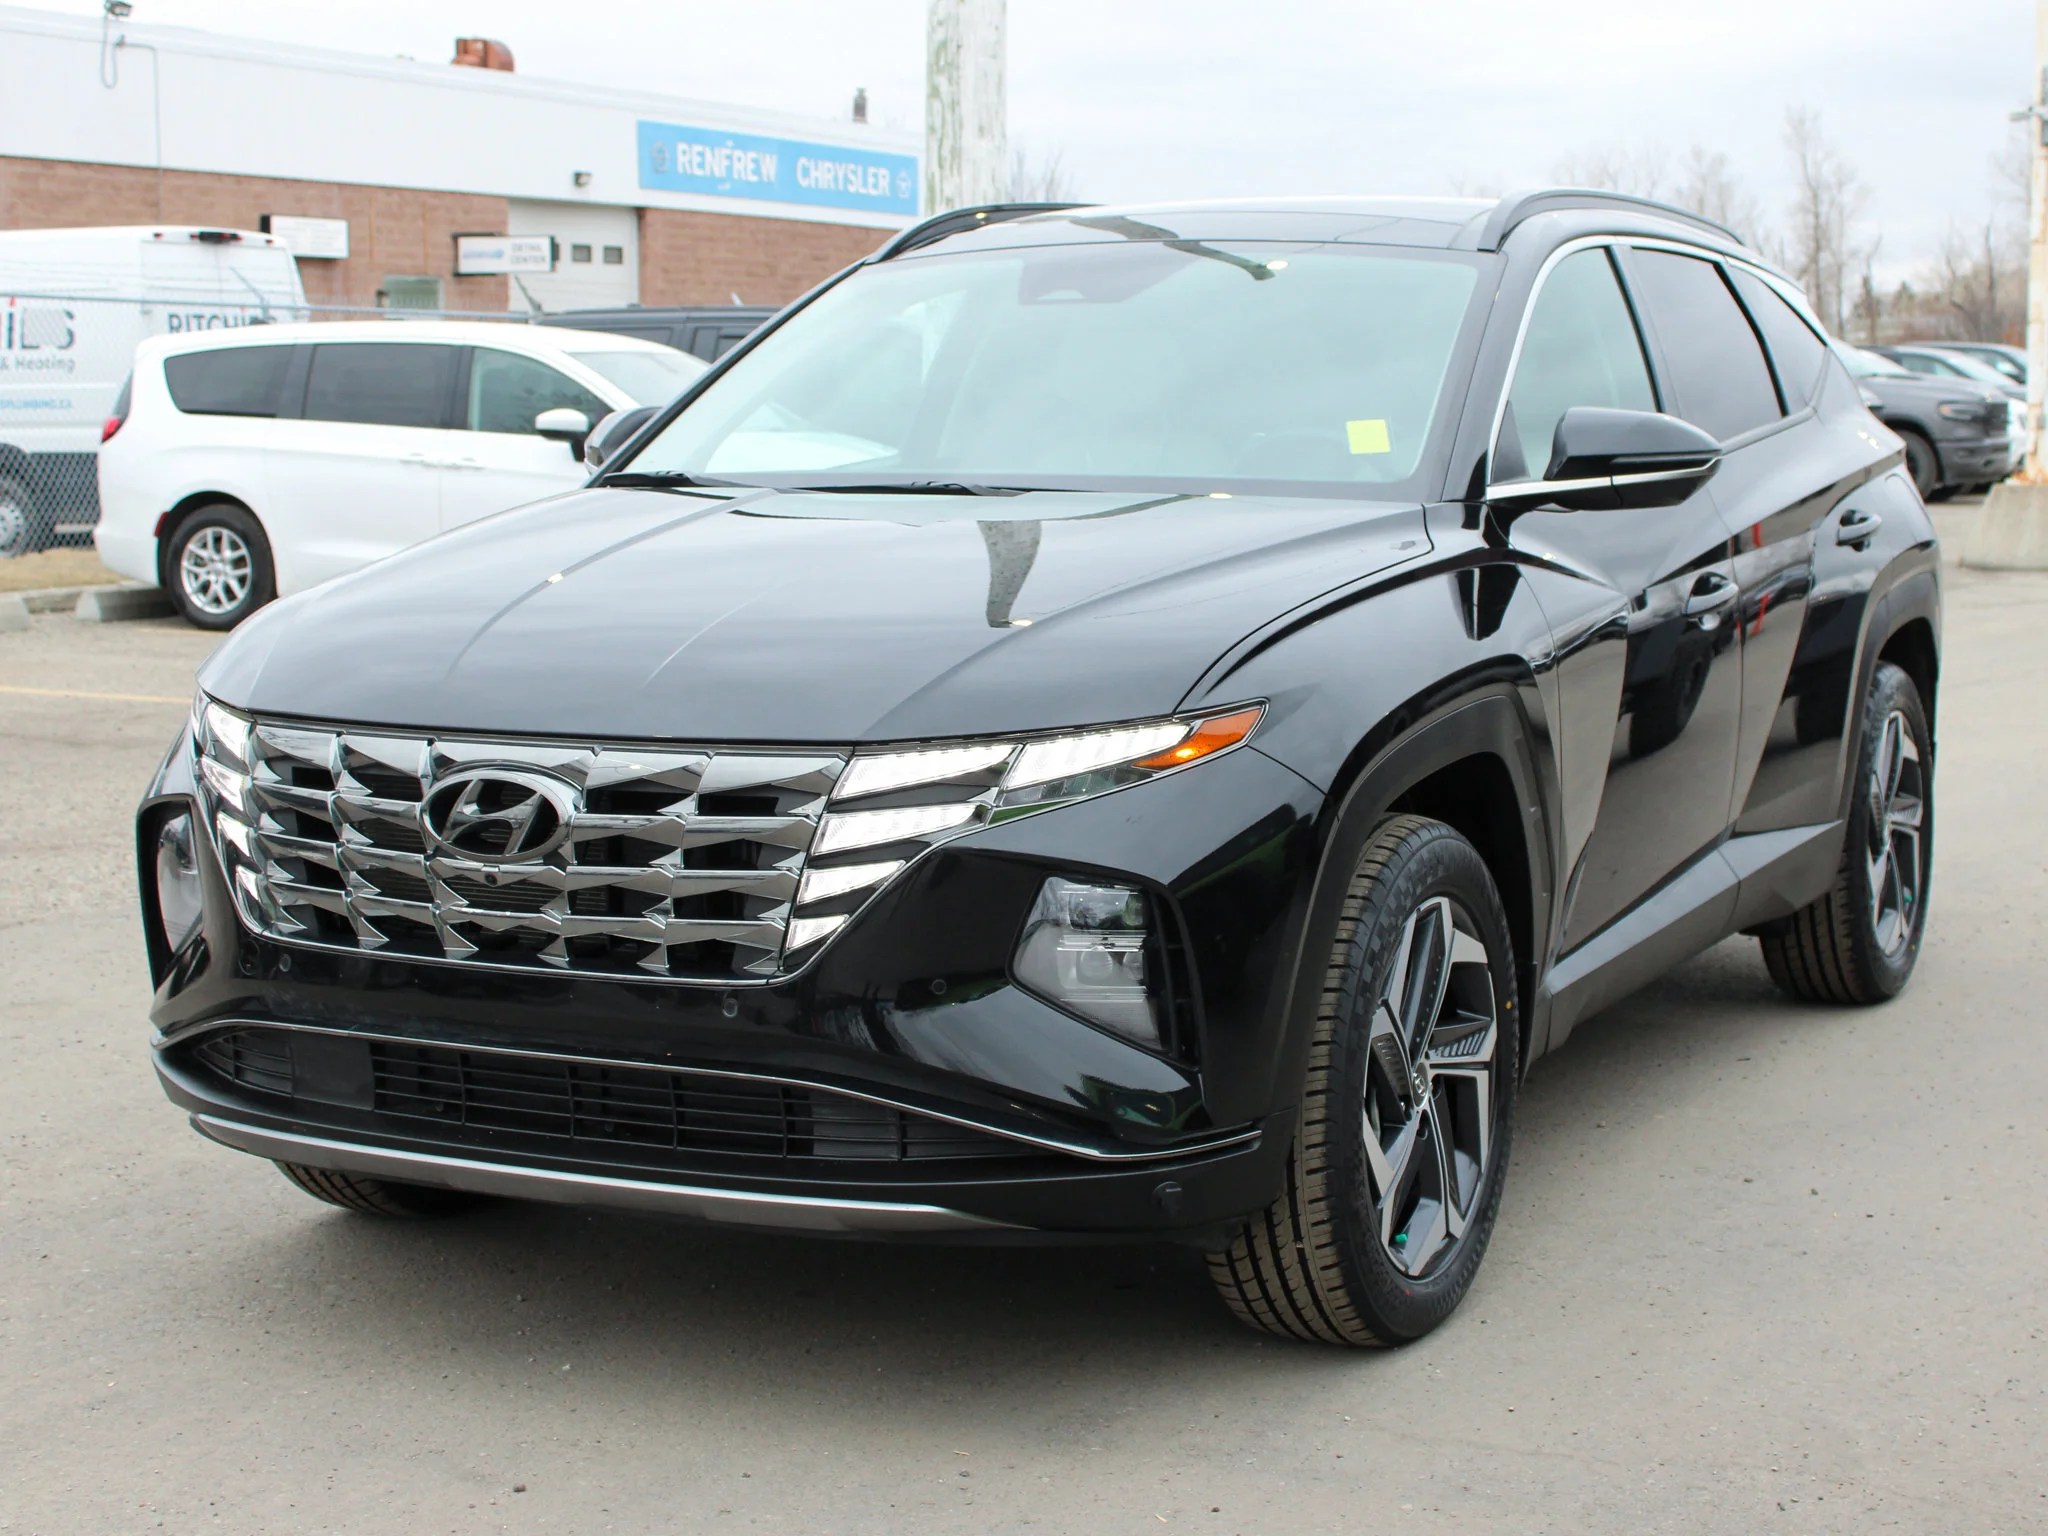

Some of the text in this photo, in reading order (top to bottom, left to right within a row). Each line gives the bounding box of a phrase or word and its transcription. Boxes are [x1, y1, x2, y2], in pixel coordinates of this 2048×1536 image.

[676, 142, 890, 197] RENFREW CHRYSLER
[14, 355, 76, 374] Heating
